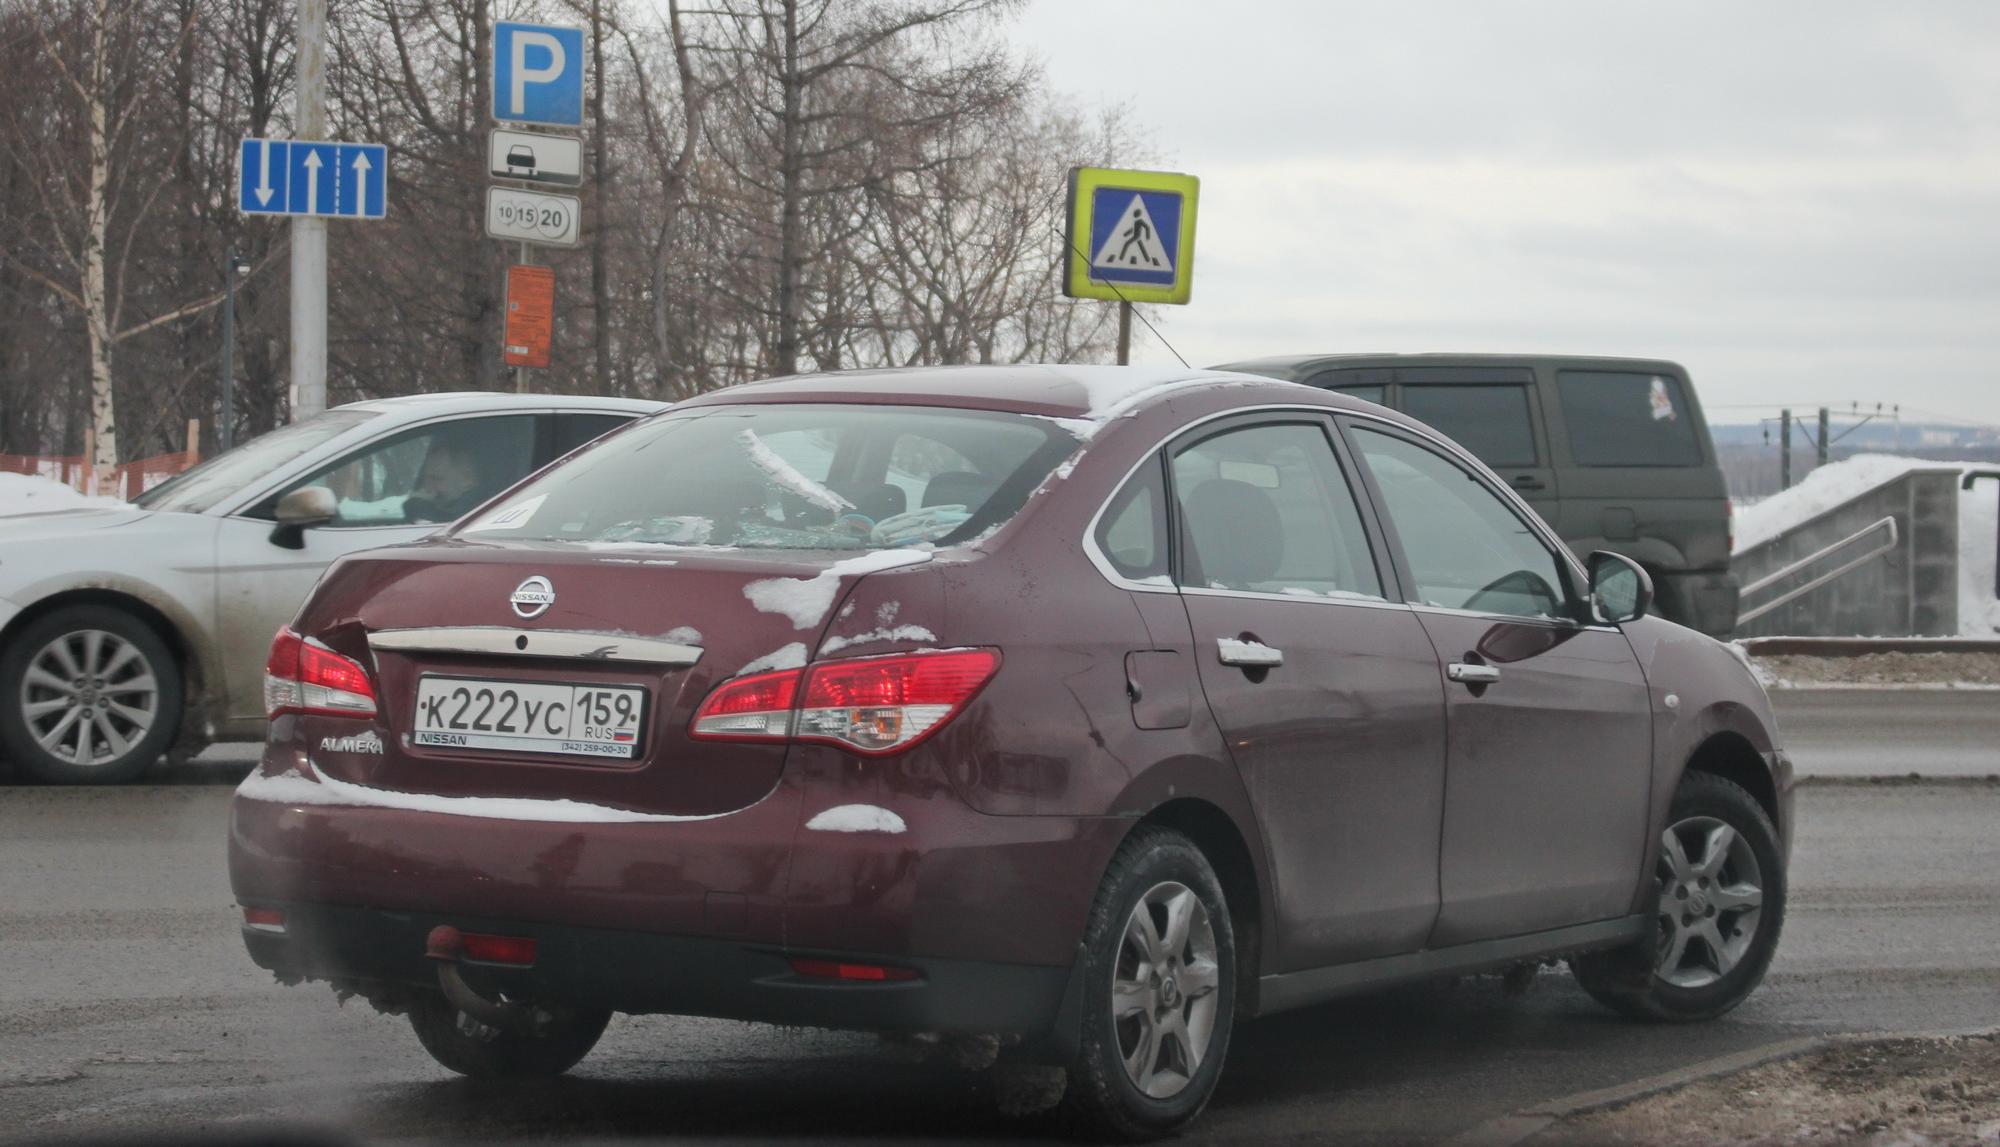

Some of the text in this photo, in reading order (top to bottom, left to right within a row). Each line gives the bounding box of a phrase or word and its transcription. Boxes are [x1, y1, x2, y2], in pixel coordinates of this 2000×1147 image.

[511, 30, 566, 114] P
[498, 206, 562, 227] 10 15 20
[513, 593, 549, 602] NISSAN
[577, 691, 633, 727] 159
[420, 733, 467, 746] NISSAN
[585, 726, 613, 740] RUS
[319, 737, 384, 755] ALMERA
[561, 743, 582, 752] (342)
